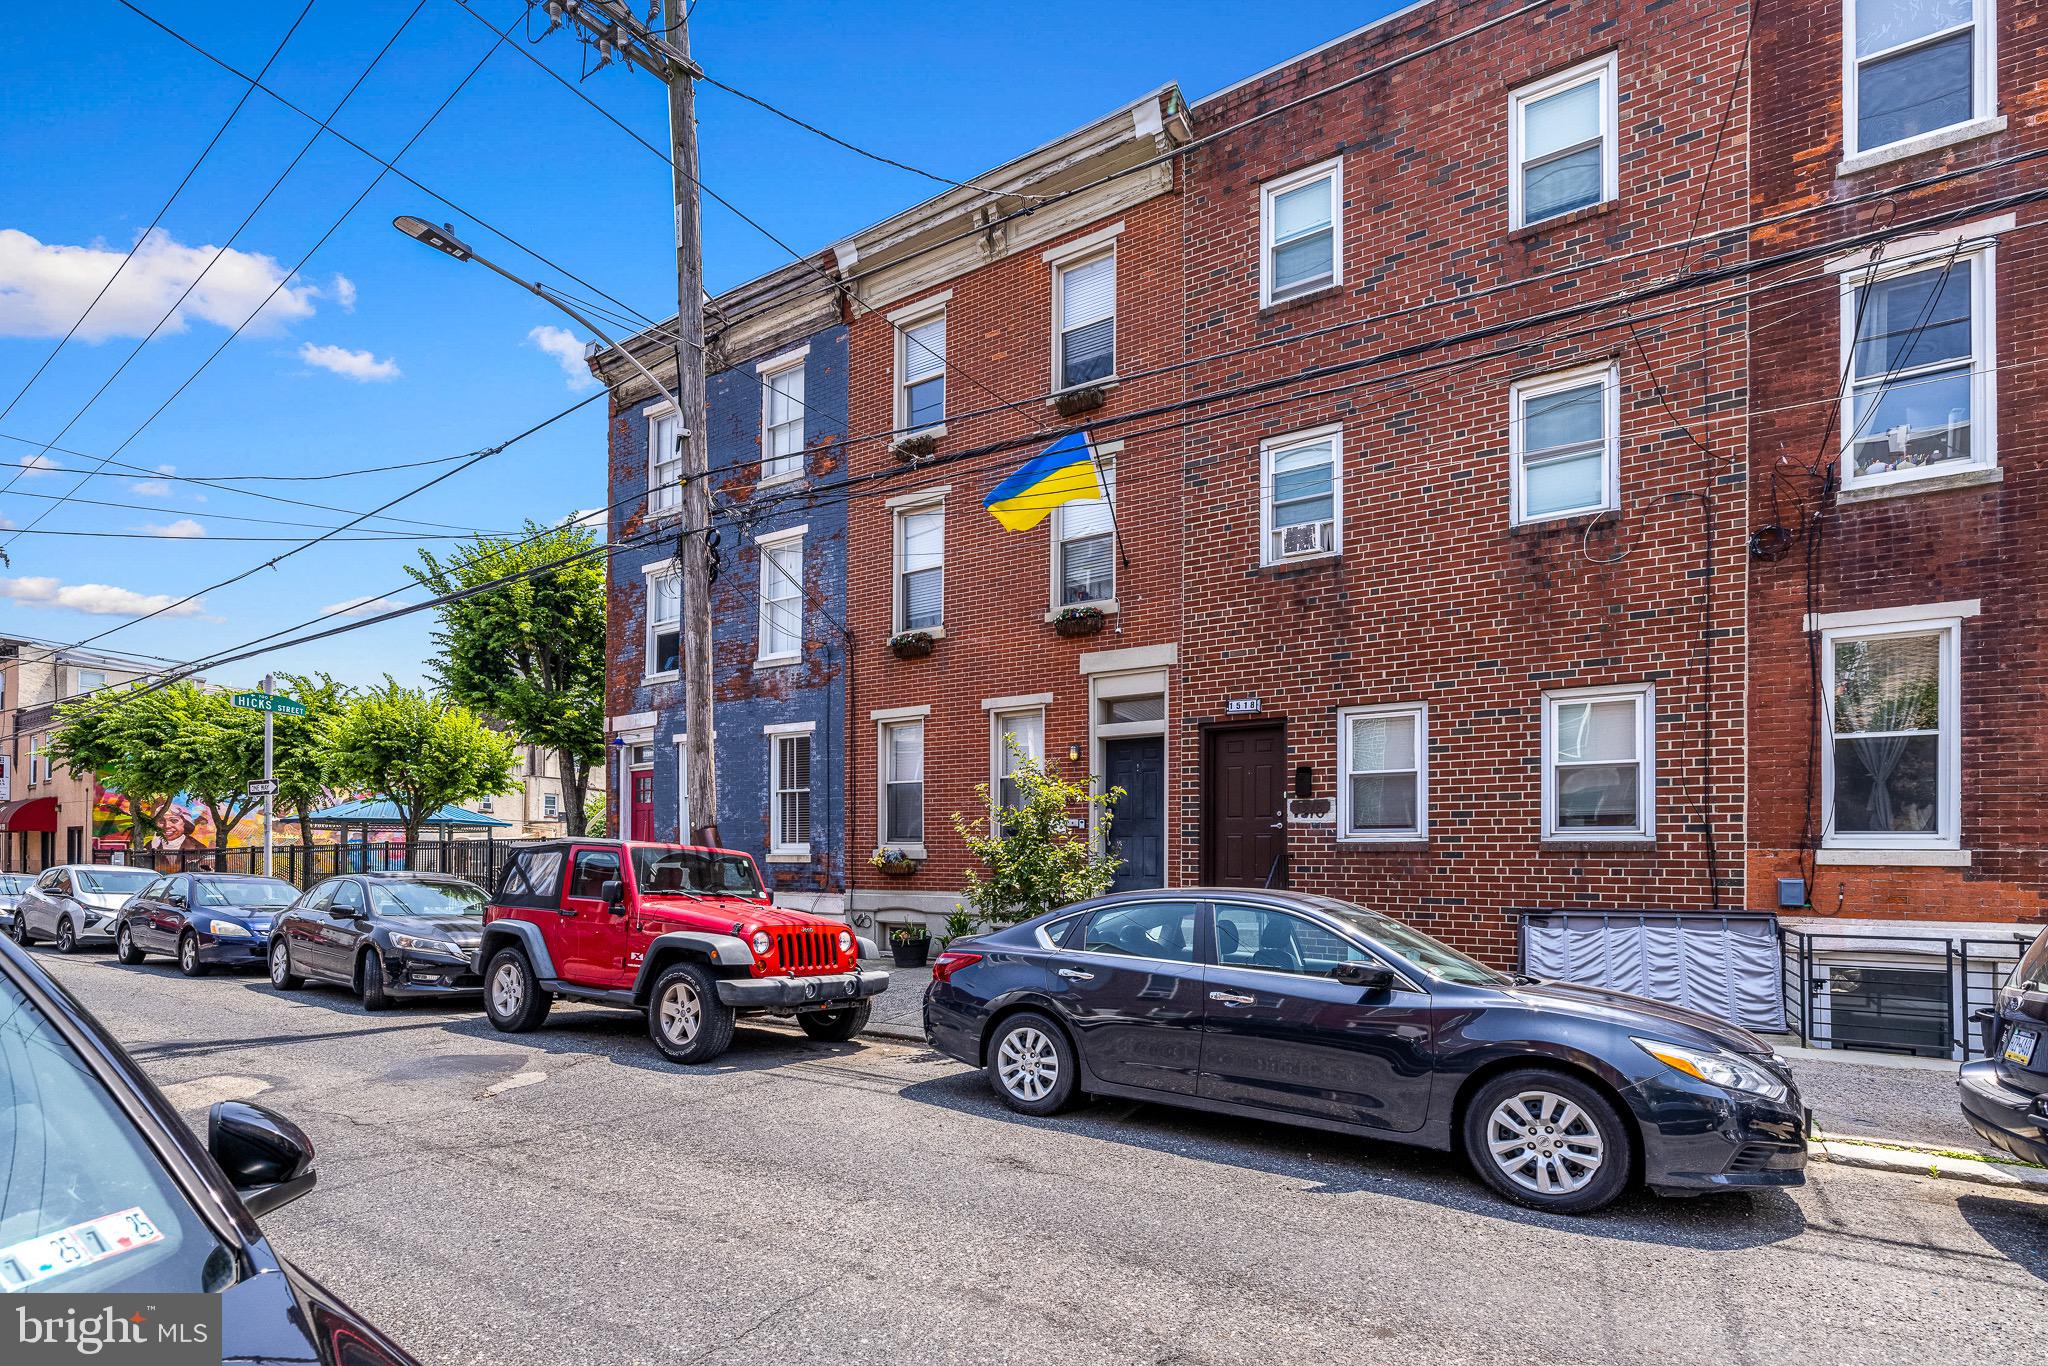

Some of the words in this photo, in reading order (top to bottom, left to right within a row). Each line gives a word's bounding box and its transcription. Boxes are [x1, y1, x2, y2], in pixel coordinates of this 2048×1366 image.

[238, 695, 272, 710] HICKS
[277, 704, 304, 715] STREET
[1229, 701, 1255, 710] 1518
[50, 1237, 81, 1263] 25
[125, 1213, 154, 1238] 25
